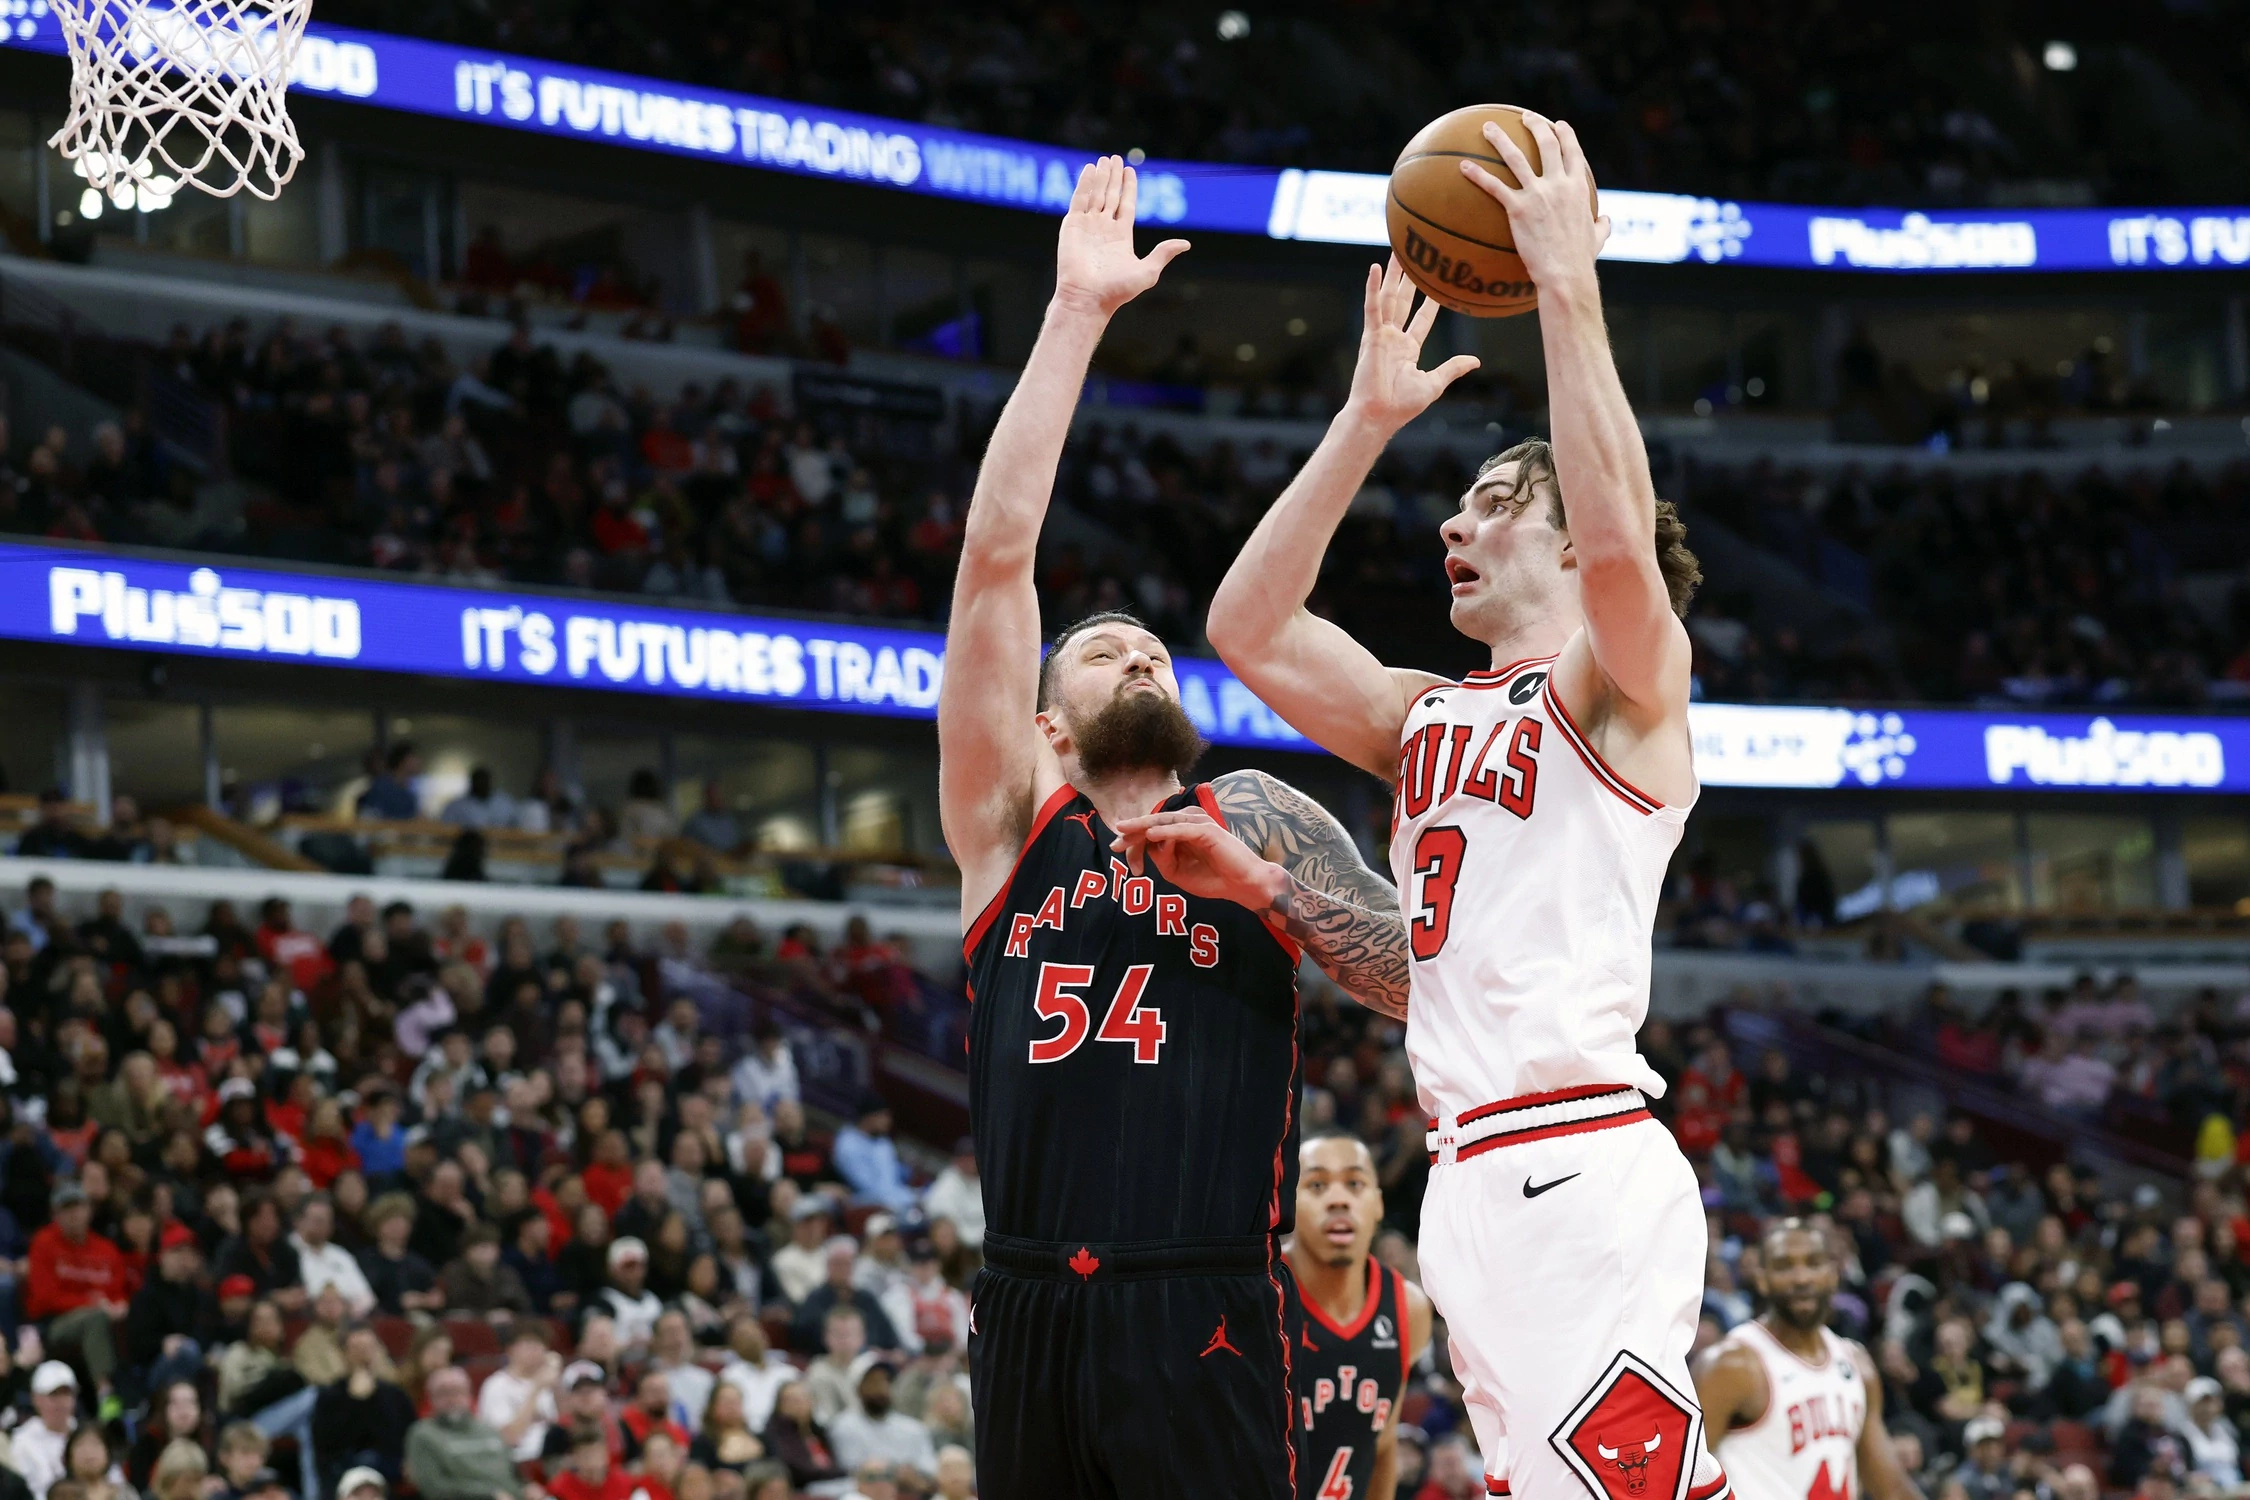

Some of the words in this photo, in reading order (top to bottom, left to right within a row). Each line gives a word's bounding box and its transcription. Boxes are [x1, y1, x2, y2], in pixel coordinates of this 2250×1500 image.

[455, 60, 535, 121] IT'S
[538, 76, 737, 153] FUTURES
[735, 107, 921, 186] TRADING
[921, 138, 1038, 209] WITH
[1404, 224, 1536, 298] Wilson
[2108, 213, 2188, 267] IT'S
[49, 566, 362, 660] Plus500
[461, 605, 558, 676] IT'S
[564, 615, 805, 697] FUTURES
[805, 638, 945, 709] TRAD
[1984, 716, 2225, 787] Plus500
[1004, 856, 1219, 968] RAPTORS
[1411, 825, 1468, 963] 3
[1029, 961, 1167, 1064] 54
[1316, 1446, 1354, 1500] 4
